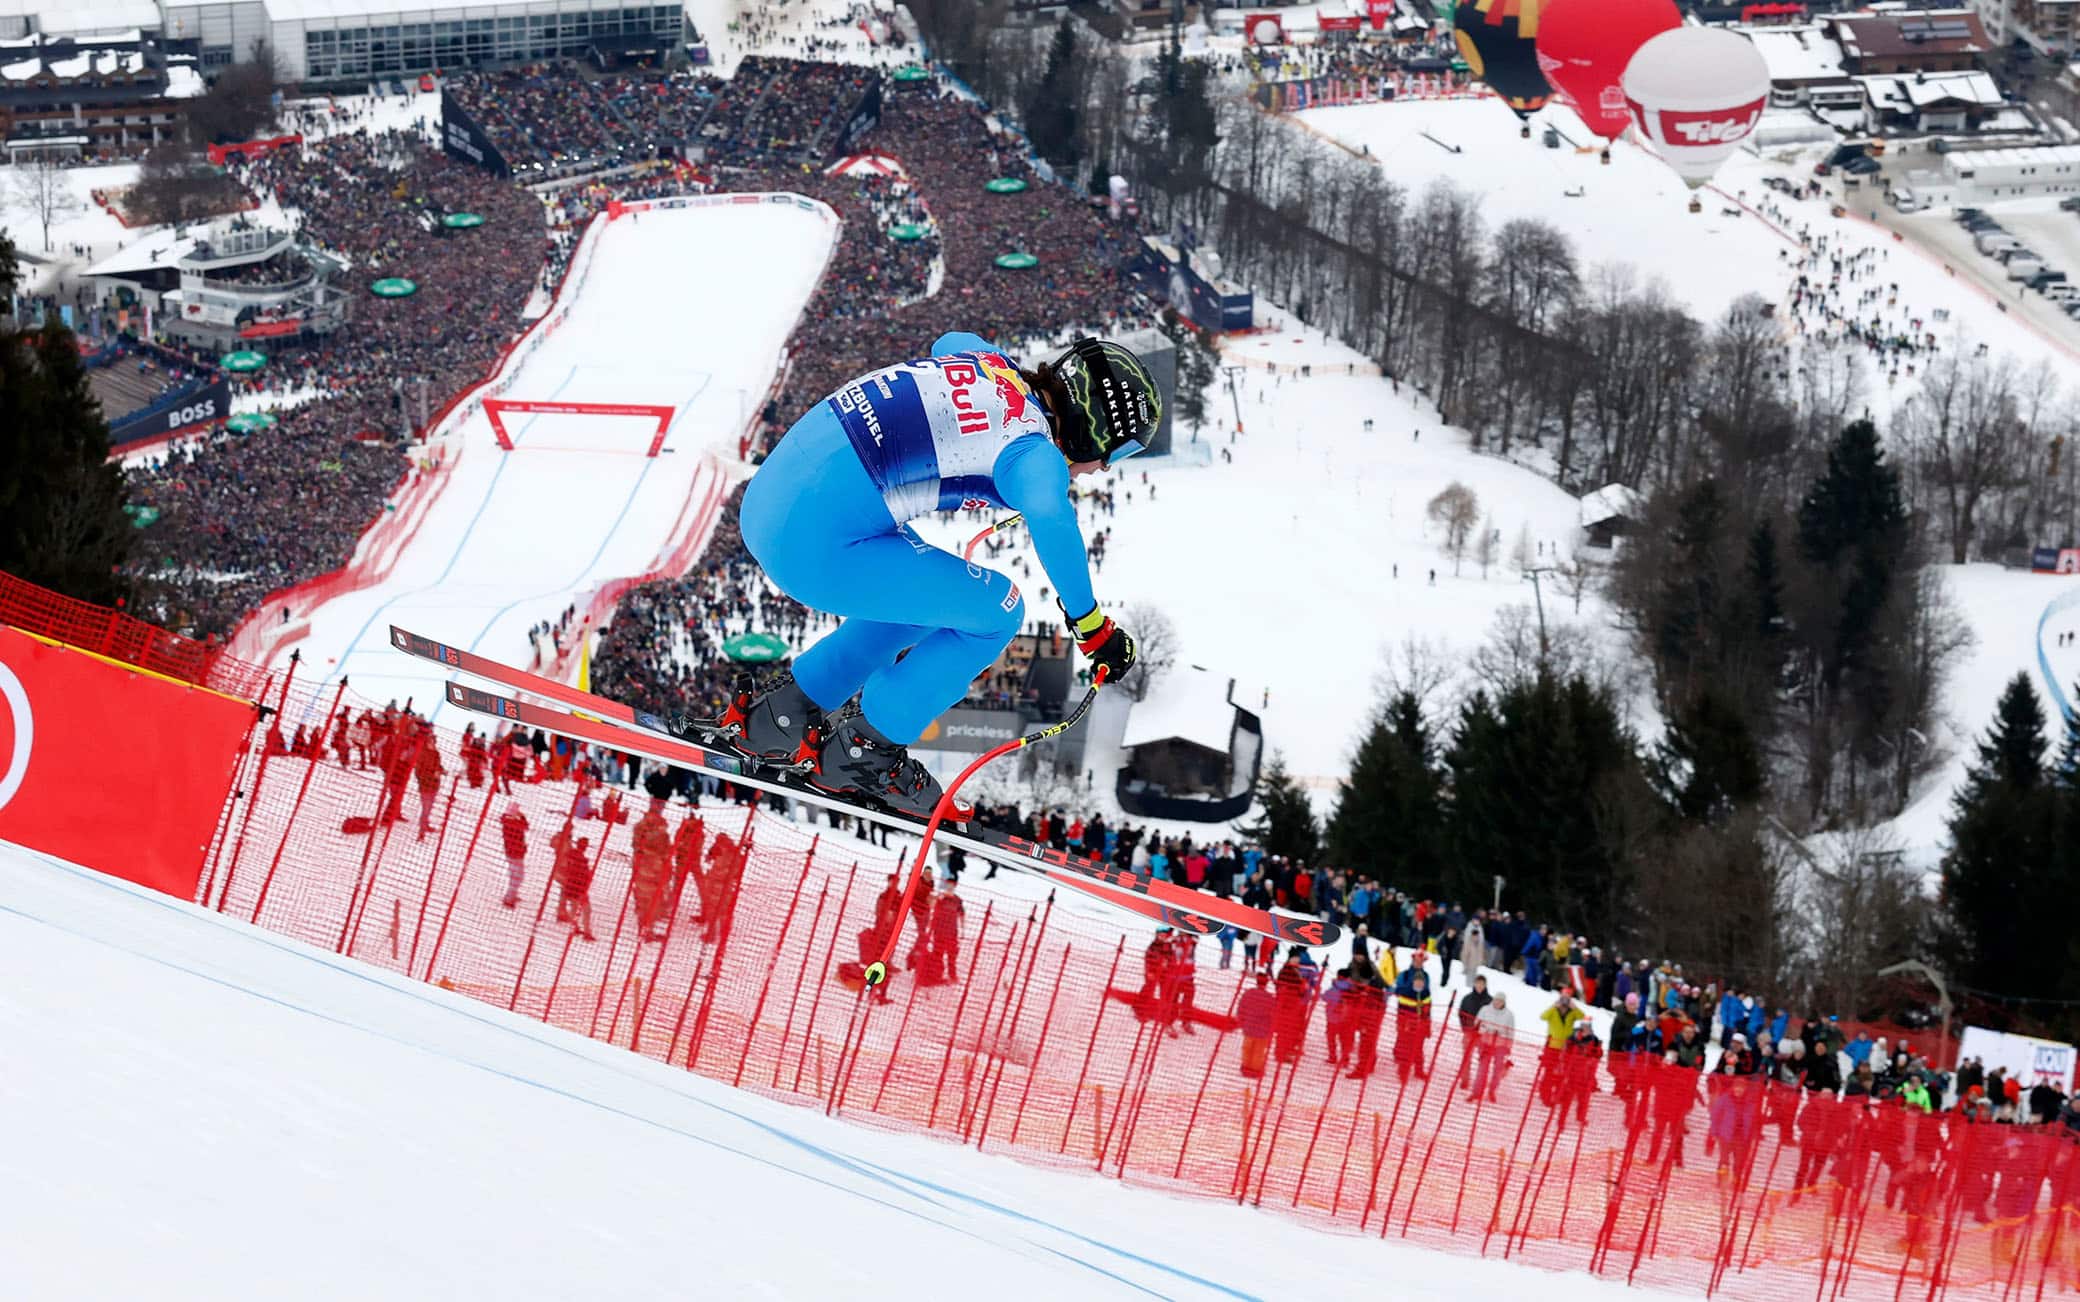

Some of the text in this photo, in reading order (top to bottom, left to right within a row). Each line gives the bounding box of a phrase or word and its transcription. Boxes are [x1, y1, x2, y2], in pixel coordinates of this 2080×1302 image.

[1675, 109, 1759, 143] Tirol
[168, 399, 217, 429] BOSS
[943, 364, 990, 435] Bull
[1102, 378, 1125, 438] OAKLEY
[1120, 381, 1137, 434] OAKLEY
[946, 723, 1014, 739] priceless
